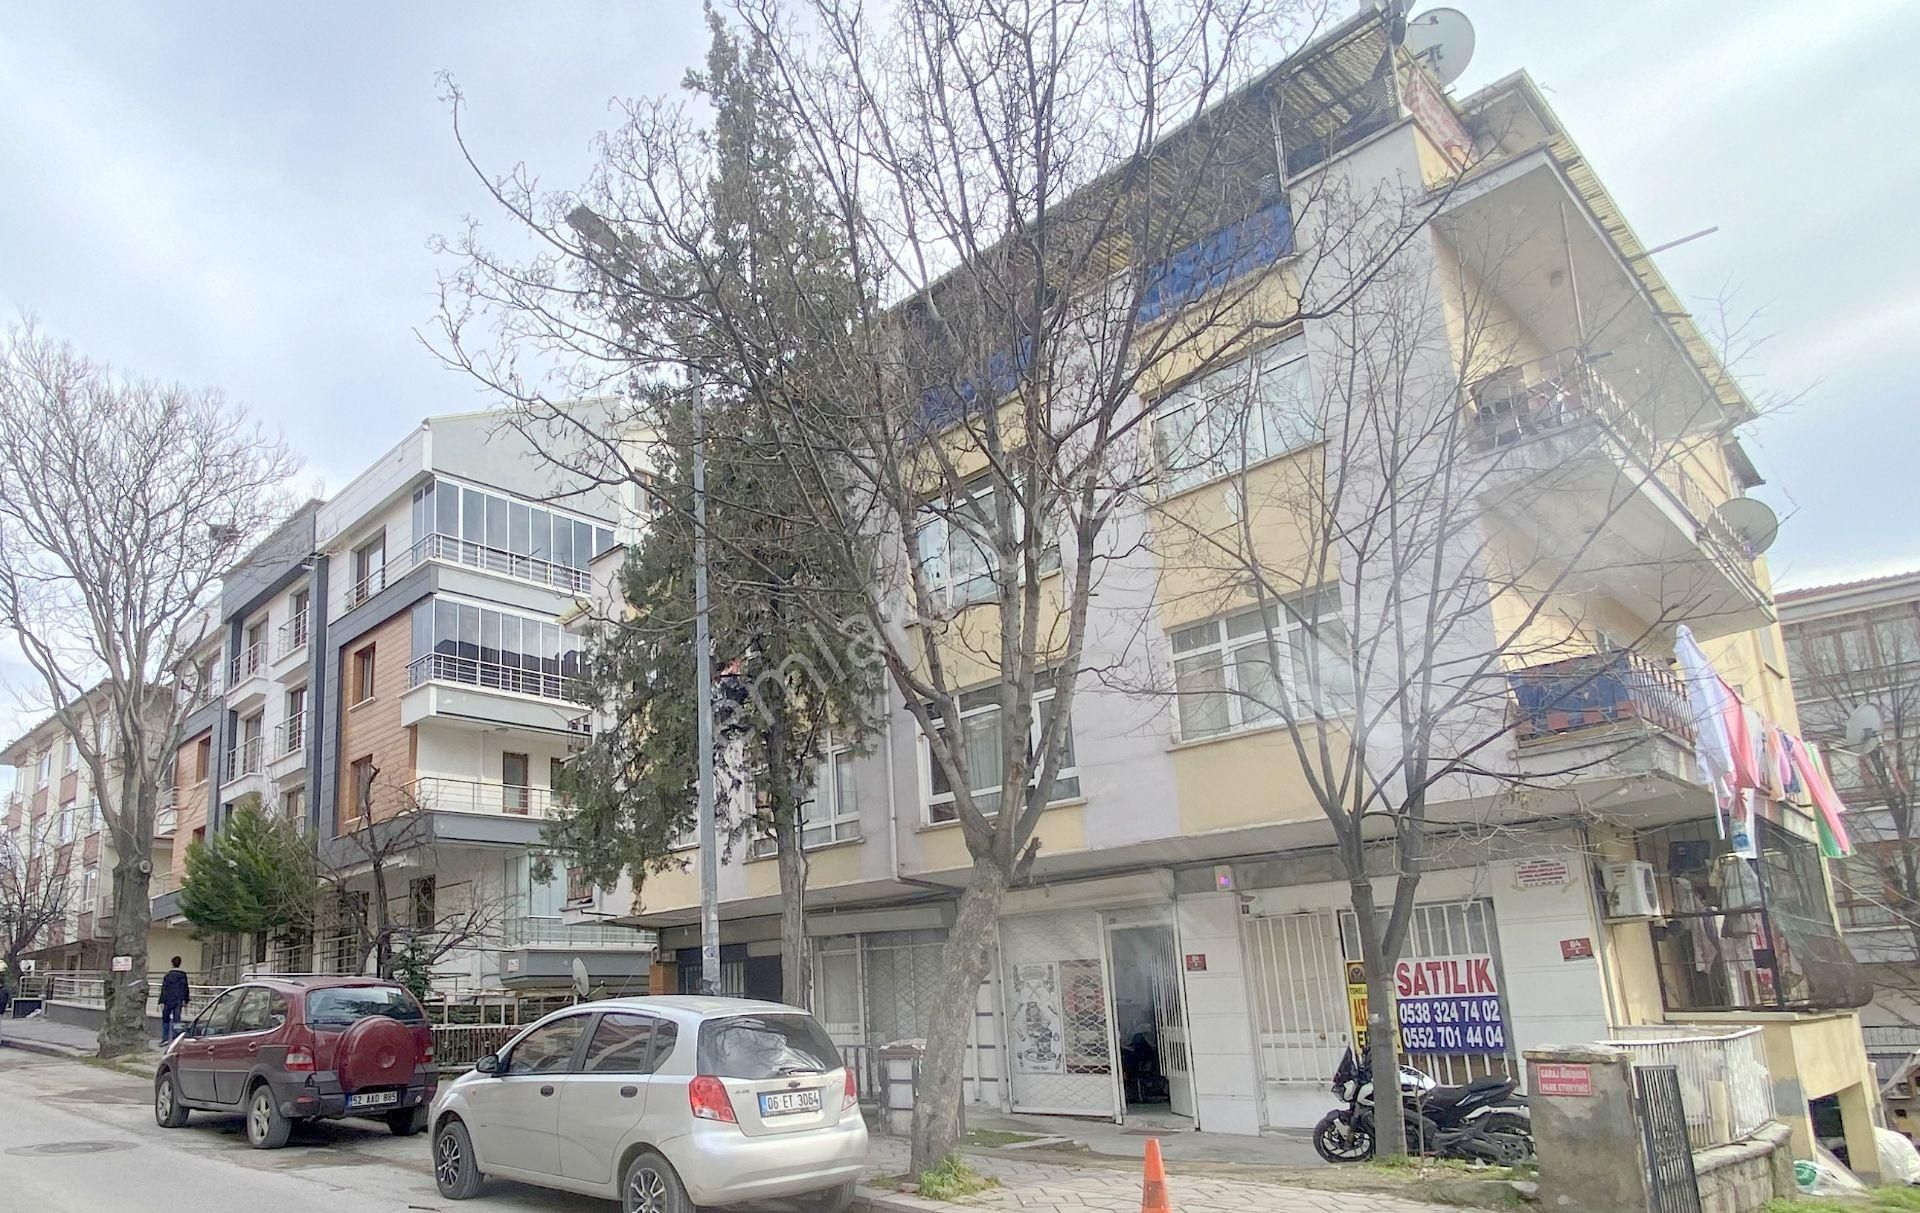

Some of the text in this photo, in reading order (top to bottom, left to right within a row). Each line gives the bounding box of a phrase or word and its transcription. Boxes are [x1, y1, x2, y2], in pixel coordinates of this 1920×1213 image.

[1396, 958, 1496, 997] SATILIK
[1400, 1000, 1500, 1025] 0538 324 74 02
[1403, 1025, 1504, 1049] 0552 701 44 04
[352, 1096, 362, 1105] 52
[767, 1092, 819, 1110] 06 ET 3064
